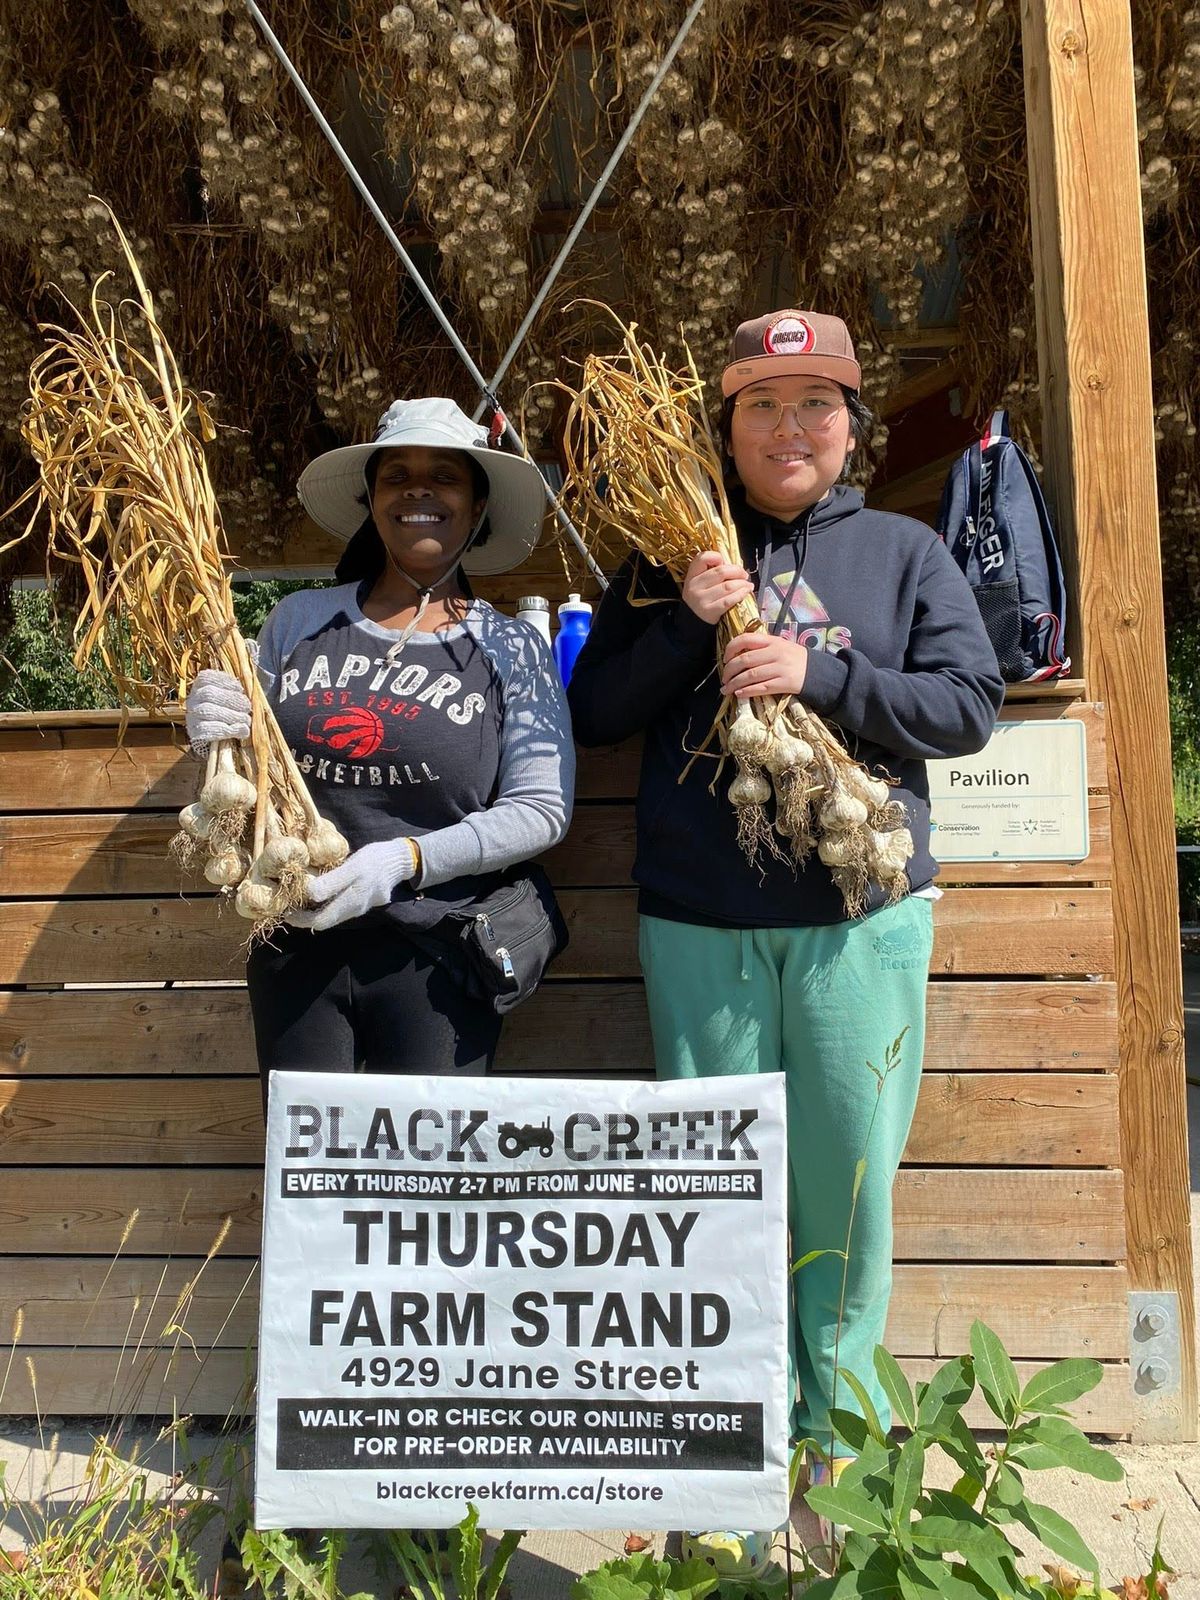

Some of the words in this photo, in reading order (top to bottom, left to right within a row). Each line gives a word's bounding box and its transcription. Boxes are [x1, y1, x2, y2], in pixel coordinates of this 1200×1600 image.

[980, 459, 1005, 575] HILFIGER
[279, 653, 486, 725] RAPTORS
[366, 693, 422, 721] 1995
[291, 748, 440, 786] SKETBALL
[950, 769, 1030, 787] Pavilion
[938, 823, 980, 832] Conservation
[285, 1104, 489, 1161] BLACK
[563, 1108, 759, 1161] CREEK
[286, 1173, 349, 1192] EVERY
[354, 1174, 454, 1194] THURSDAY
[459, 1178, 487, 1194] 2-7
[493, 1177, 520, 1193] PM
[526, 1176, 579, 1192] FROM
[584, 1174, 634, 1192] JUNE
[652, 1174, 756, 1193] NOVEMBER
[343, 1210, 700, 1268] THURSDAY
[309, 1290, 485, 1346] FARM
[511, 1291, 731, 1348] STAND
[341, 1357, 440, 1388] 4929
[455, 1359, 559, 1389] Jane
[575, 1359, 700, 1391] Street
[299, 1409, 400, 1427] WALK-IN
[407, 1409, 439, 1427] OR
[445, 1408, 523, 1426] CHECK
[530, 1410, 577, 1428] OUR
[584, 1411, 664, 1429] ONLINE
[671, 1413, 742, 1432] STORE
[353, 1437, 398, 1456] FOR
[404, 1437, 532, 1456] PRE-ORDER
[538, 1438, 686, 1457] AVAILABILITY
[376, 1476, 664, 1504] blackcreekfarm.ca/store
